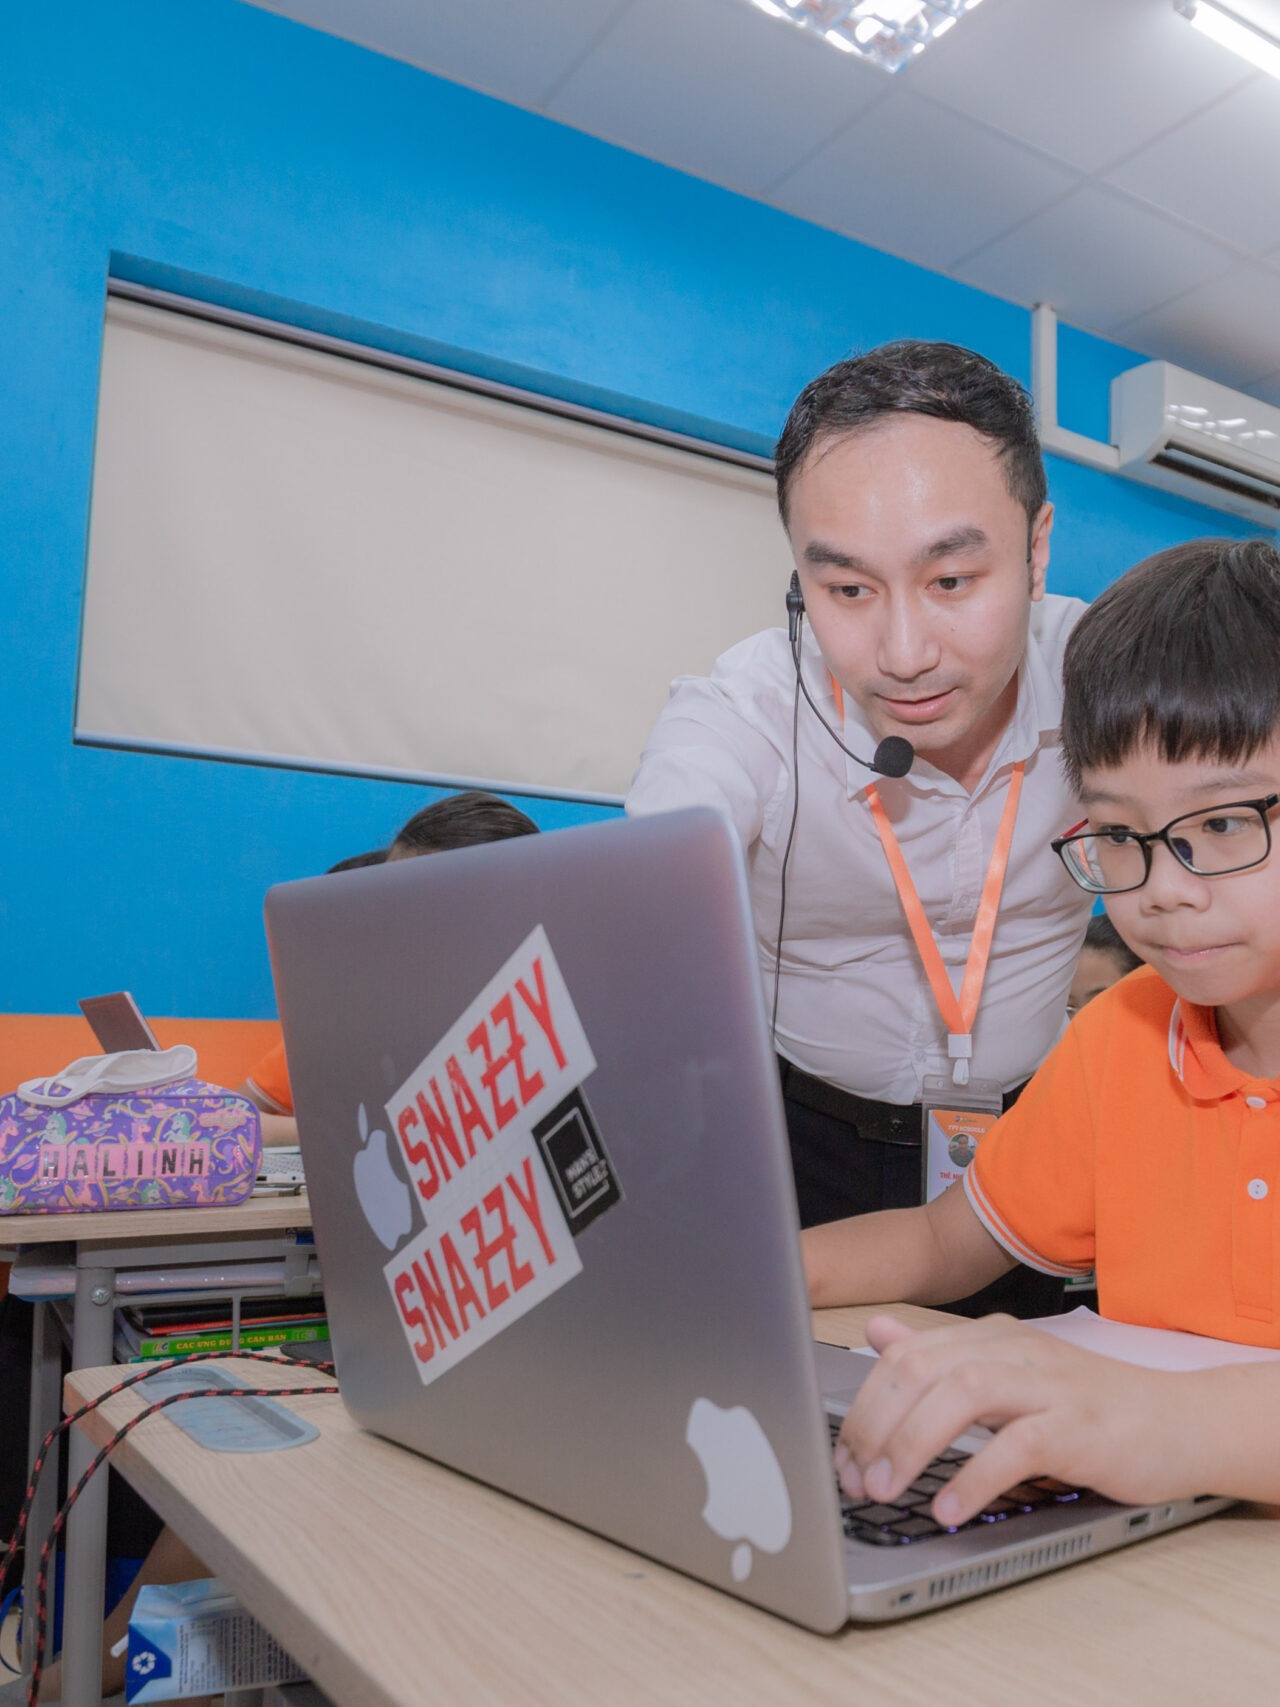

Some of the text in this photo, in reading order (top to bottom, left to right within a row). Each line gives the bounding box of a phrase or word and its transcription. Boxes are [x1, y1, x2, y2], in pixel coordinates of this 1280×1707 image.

[42, 1147, 204, 1178] HALINH
[397, 956, 568, 1201] SNAZZY
[394, 1156, 557, 1364] SNAZZY
